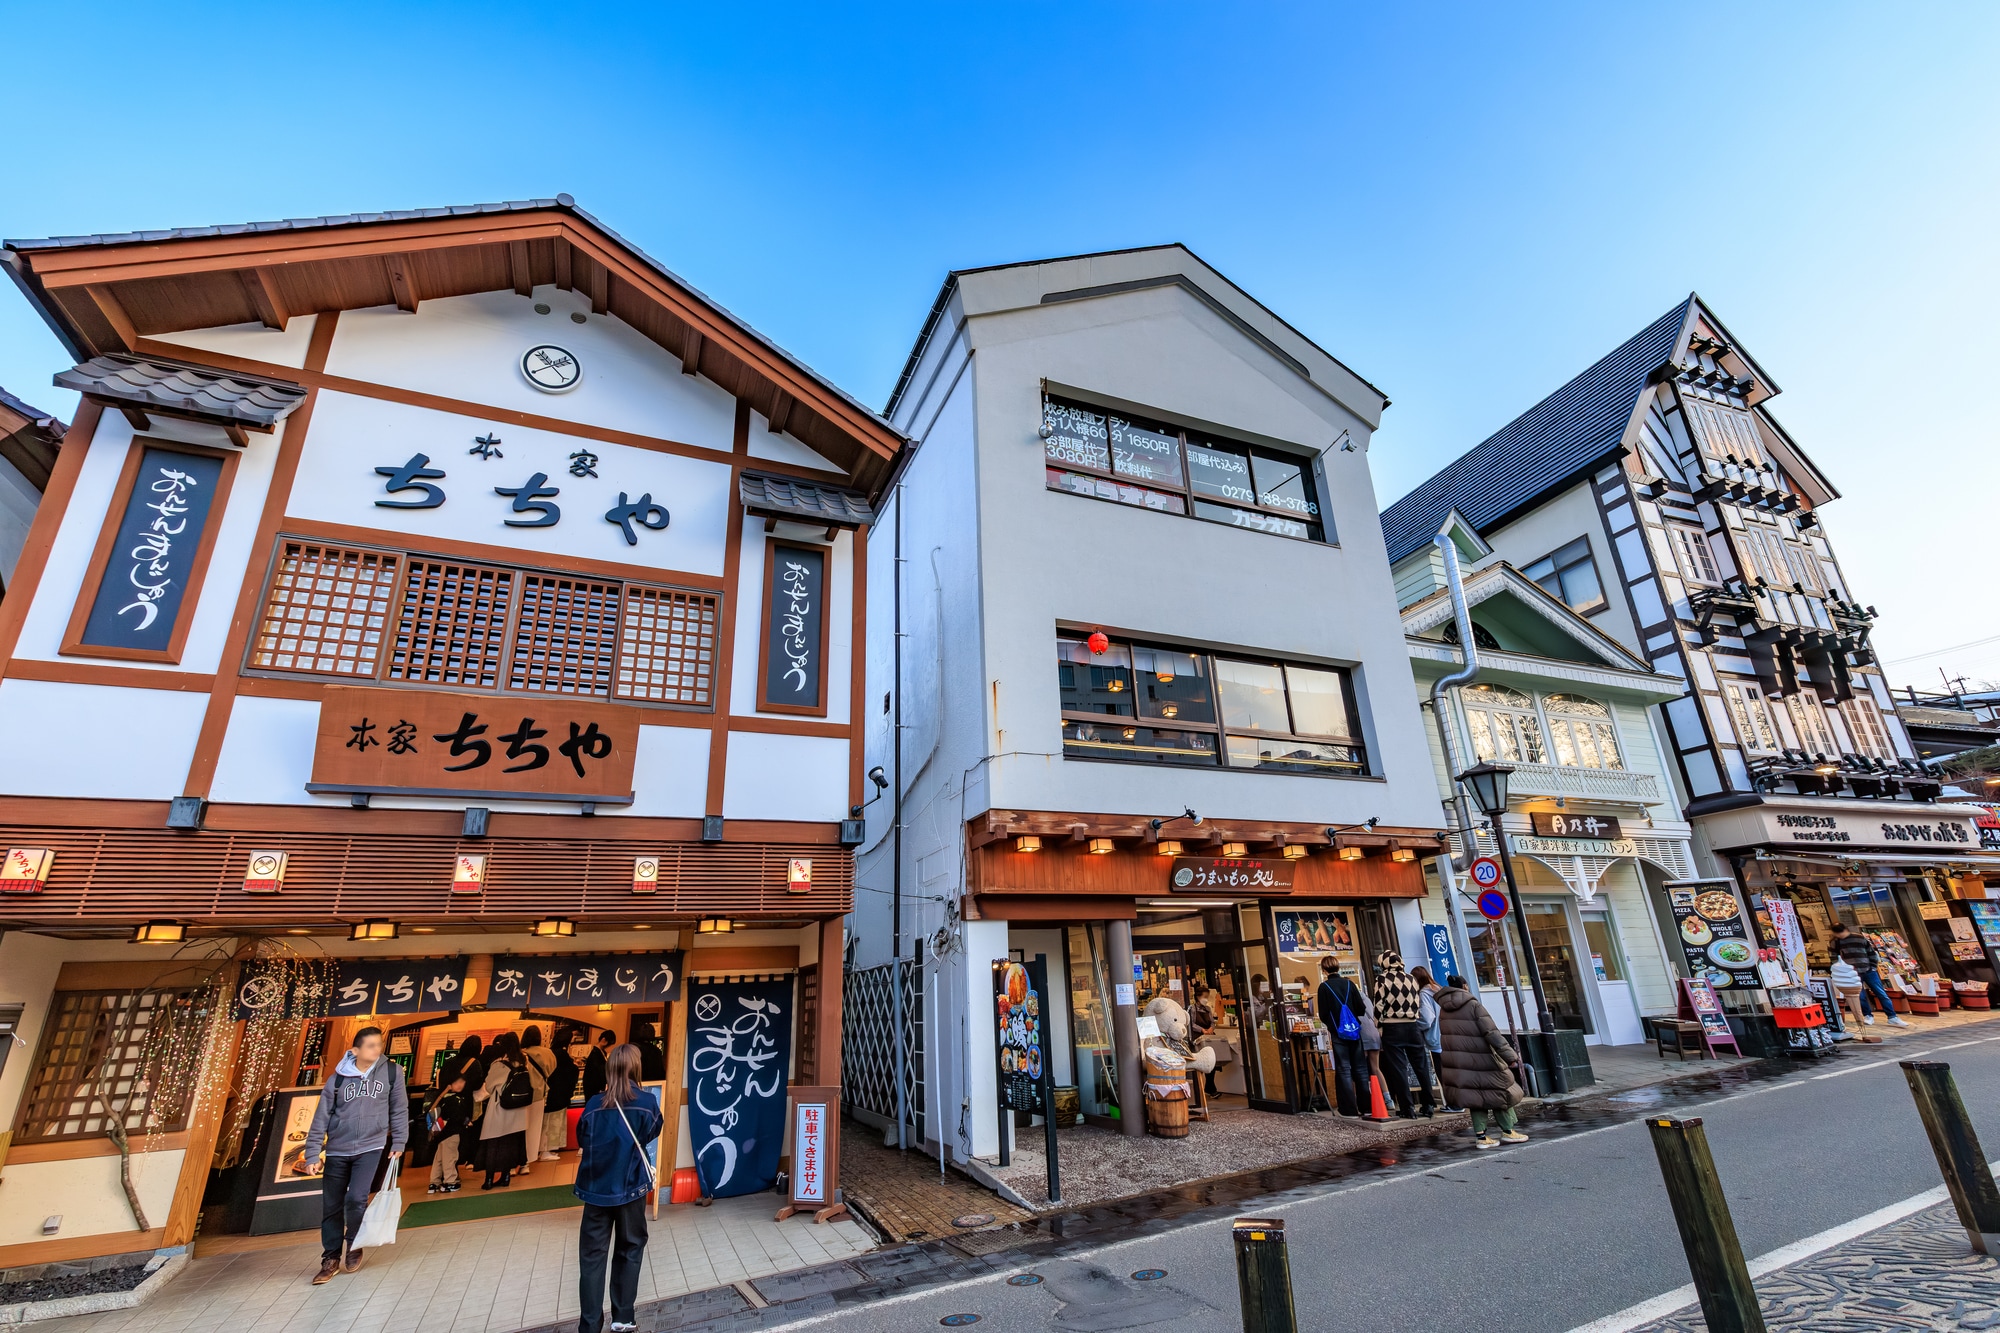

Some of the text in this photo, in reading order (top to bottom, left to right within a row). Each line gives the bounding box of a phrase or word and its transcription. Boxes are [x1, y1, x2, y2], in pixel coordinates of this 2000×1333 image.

[469, 433, 598, 478] 本家
[1045, 435, 1135, 461] お部屋代プラン
[1127, 432, 1170, 455] 1650円
[374, 452, 669, 546] ちちや
[1071, 475, 1168, 511] カラオケ
[1221, 484, 1318, 515] 0279-88-3788
[1231, 509, 1300, 536] カラオケ
[118, 466, 197, 631] おんせんまんじゅう
[782, 561, 810, 691] おんせんまんじゅう
[345, 712, 613, 778] 本家 ちちや
[1592, 842, 1633, 854] レストラン
[12, 850, 35, 878] ちちや
[459, 856, 479, 881] ちちや
[793, 859, 810, 881] ちちや
[1195, 867, 1274, 887] うまいもの処
[1476, 865, 1495, 880] 20
[338, 974, 458, 1007] ちちや
[494, 963, 674, 998] おんせんまんじゅう
[344, 1078, 384, 1103] GAP
[803, 1108, 819, 1196] 駐車できません
